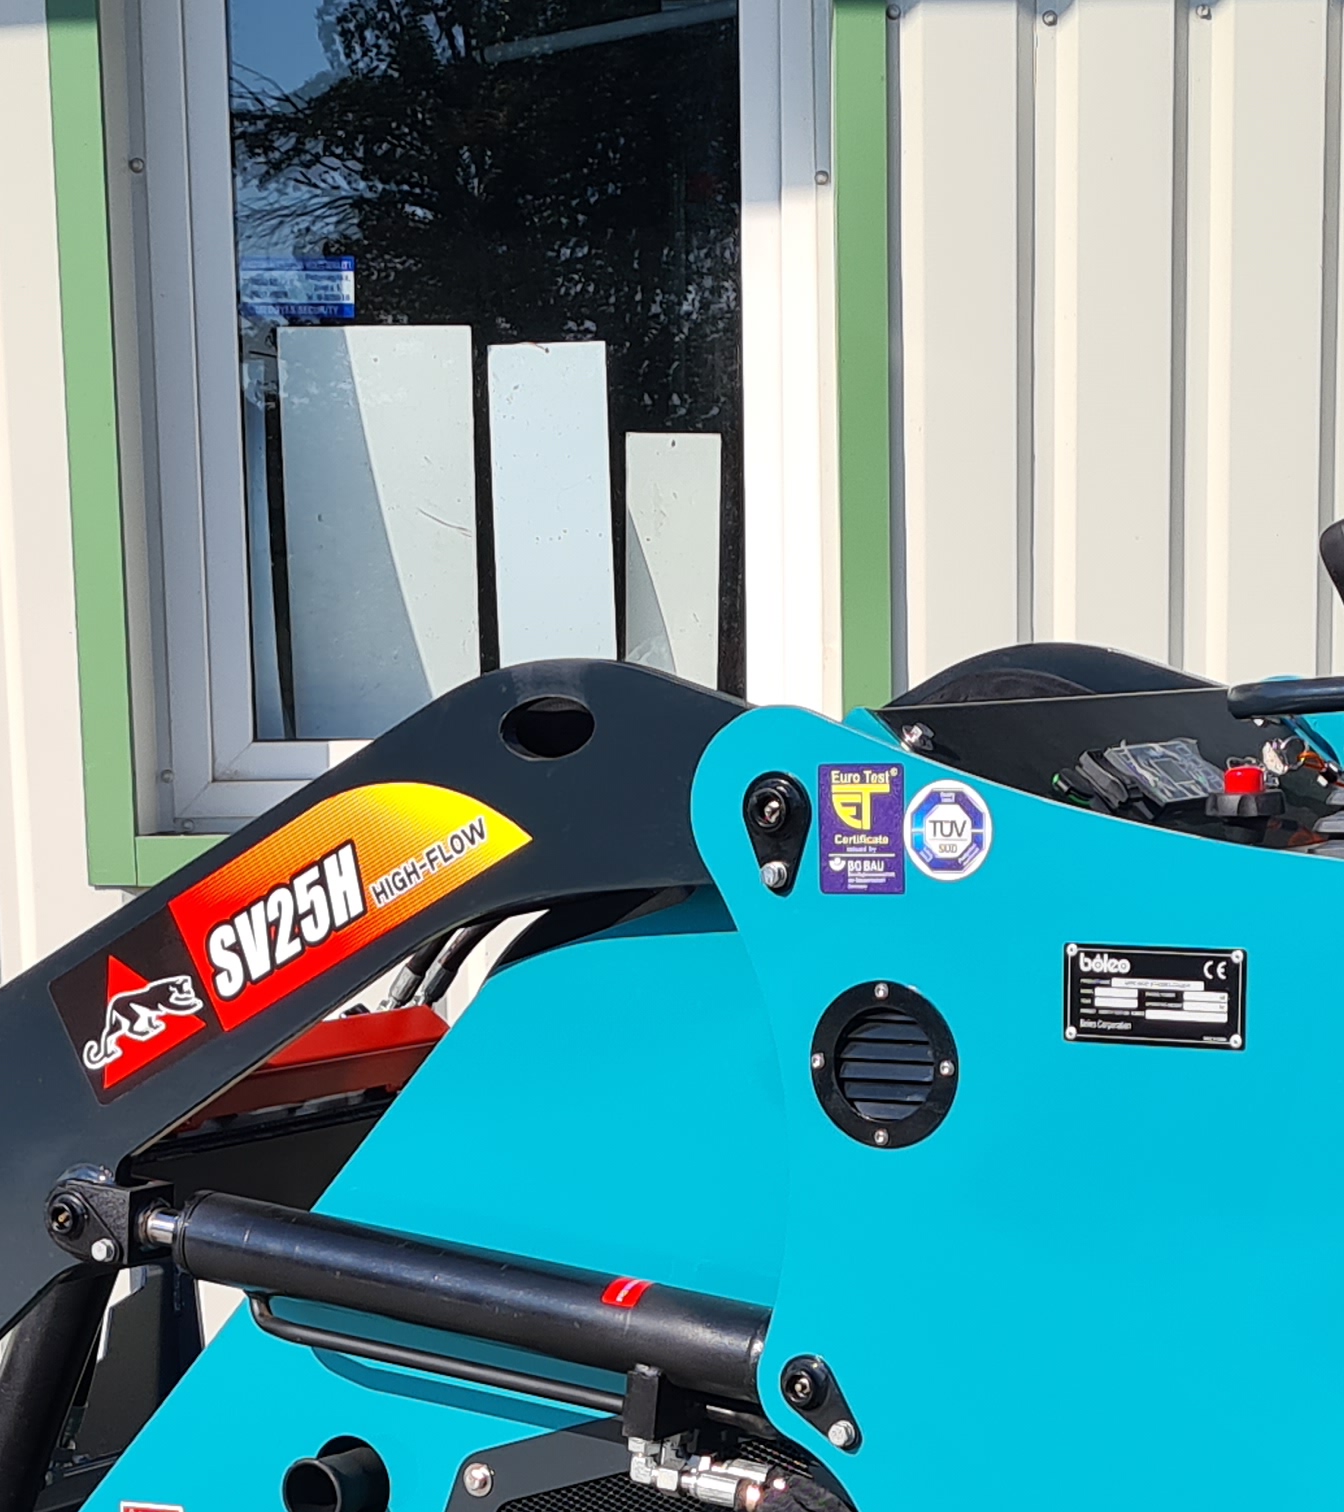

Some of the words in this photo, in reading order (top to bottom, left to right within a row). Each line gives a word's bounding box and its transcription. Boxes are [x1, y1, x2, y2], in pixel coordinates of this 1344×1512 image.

[830, 770, 860, 784] Euro
[928, 819, 968, 838] TÜV
[371, 817, 488, 906] HIGH-FLOW
[863, 859, 884, 872] BAU
[206, 839, 368, 1000] SV25H
